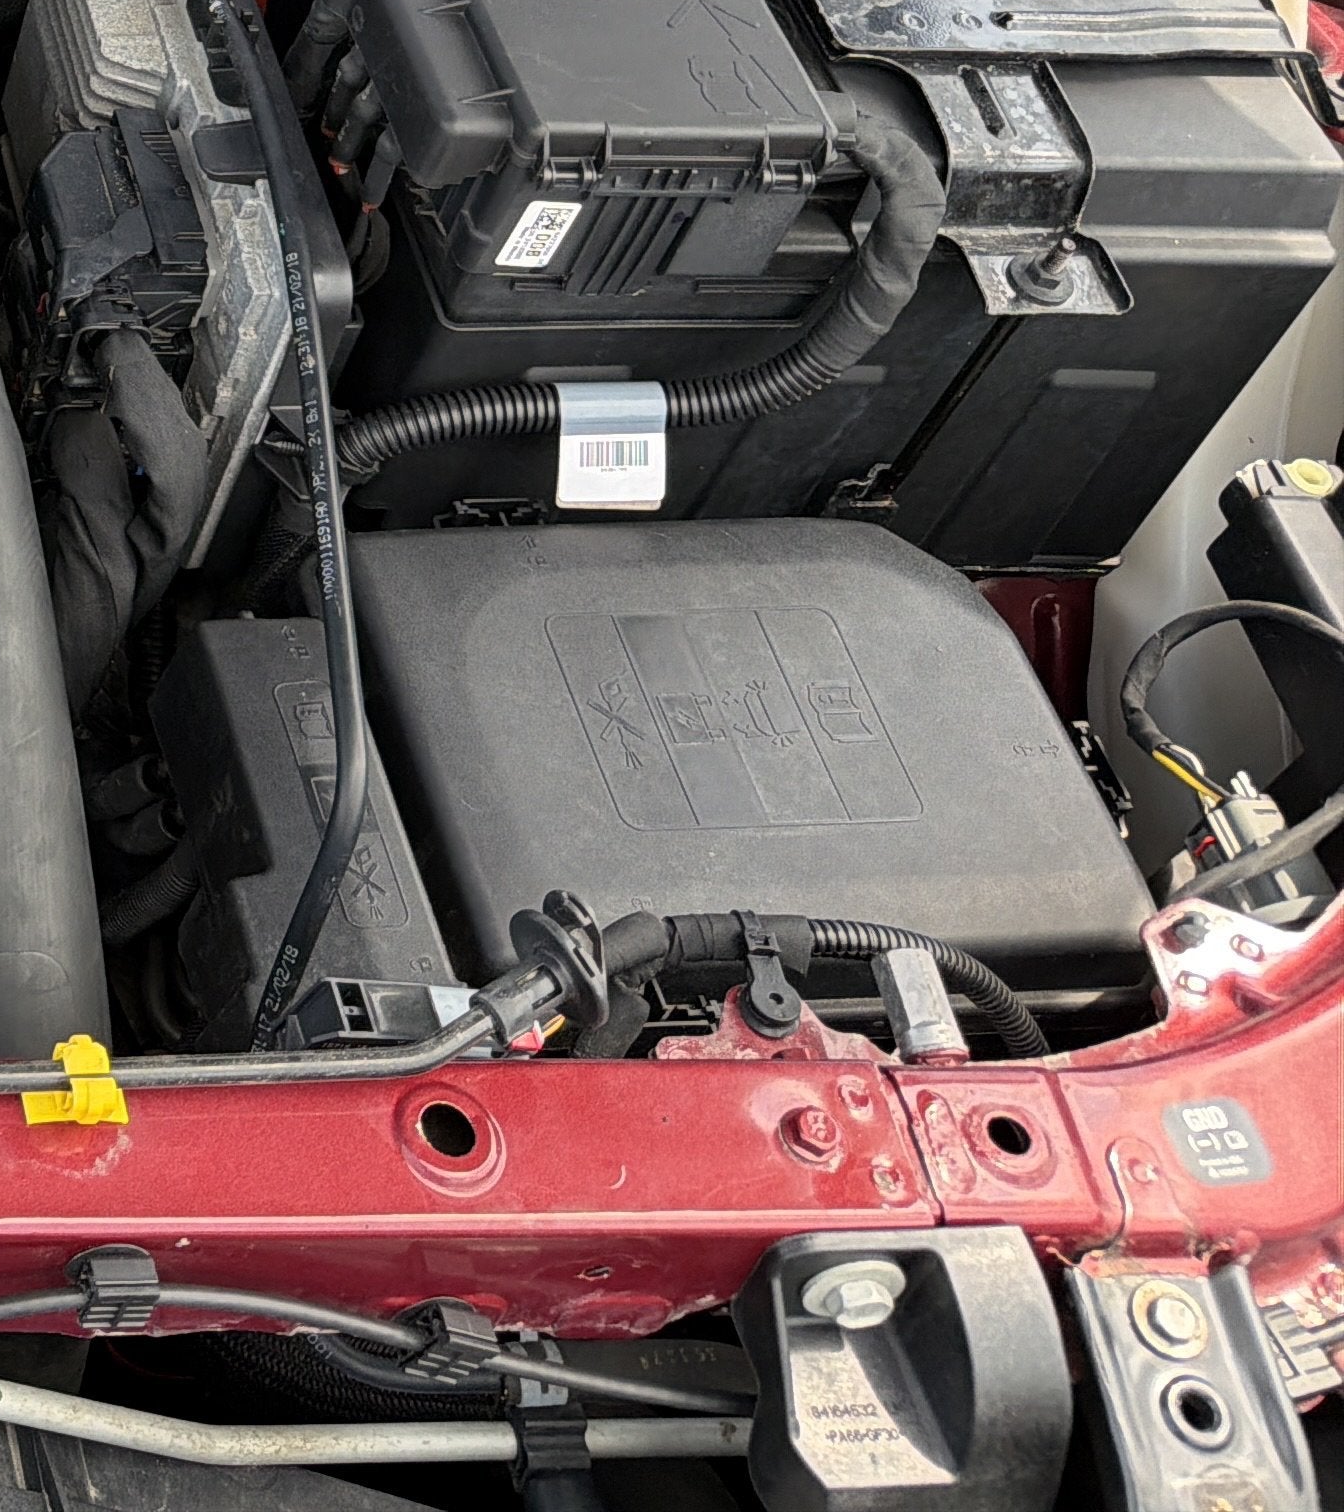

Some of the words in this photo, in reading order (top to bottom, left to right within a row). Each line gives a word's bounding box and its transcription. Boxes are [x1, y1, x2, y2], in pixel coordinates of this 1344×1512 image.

[285, 252, 305, 313] 21/02/18
[265, 944, 299, 1013] 21/02/18
[1182, 1106, 1229, 1133] GND
